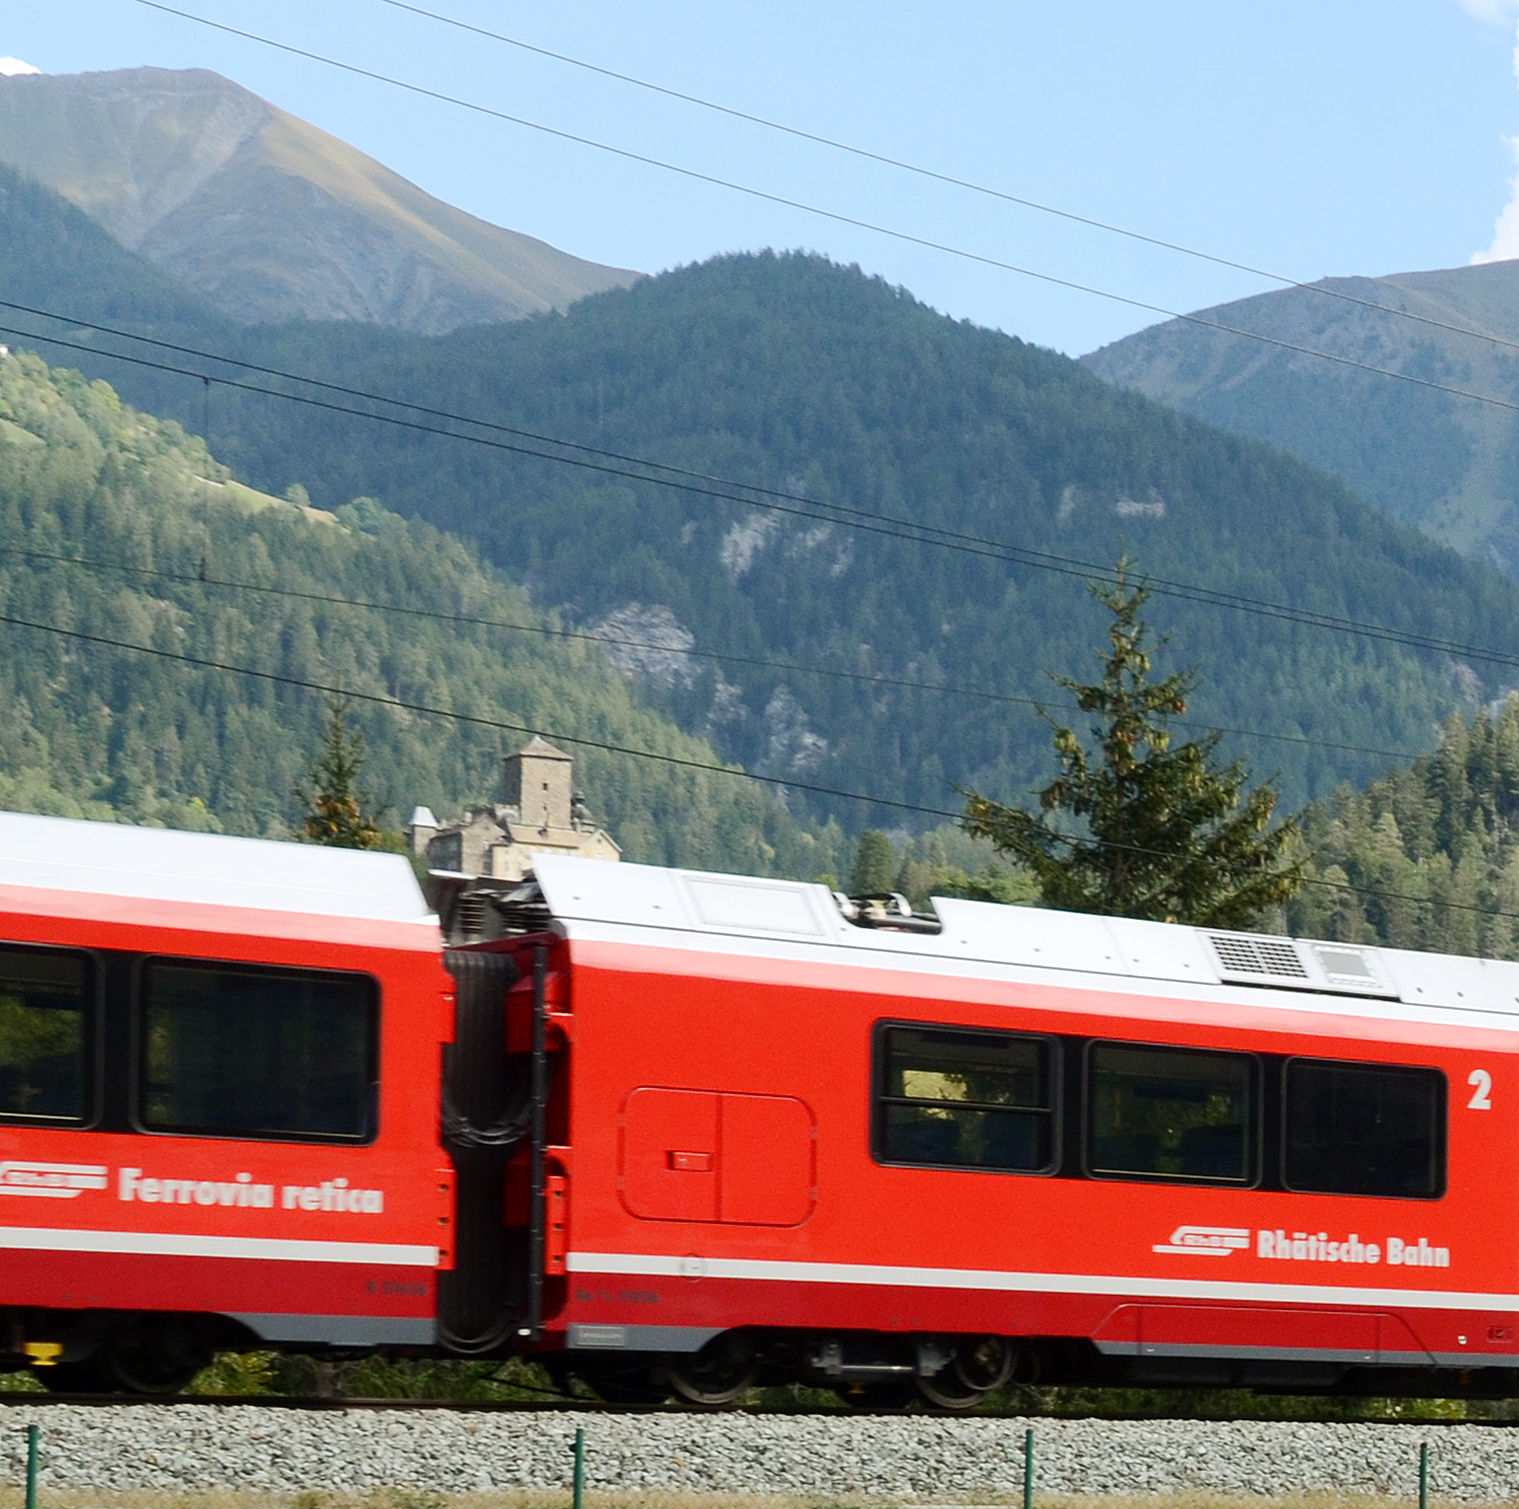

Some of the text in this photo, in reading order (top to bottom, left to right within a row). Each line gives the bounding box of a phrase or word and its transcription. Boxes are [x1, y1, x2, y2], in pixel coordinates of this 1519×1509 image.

[1466, 1069, 1492, 1110] 2
[118, 1167, 384, 1213] Ferrovia retica
[1257, 1229, 1450, 1267] Rhätische Bahn
